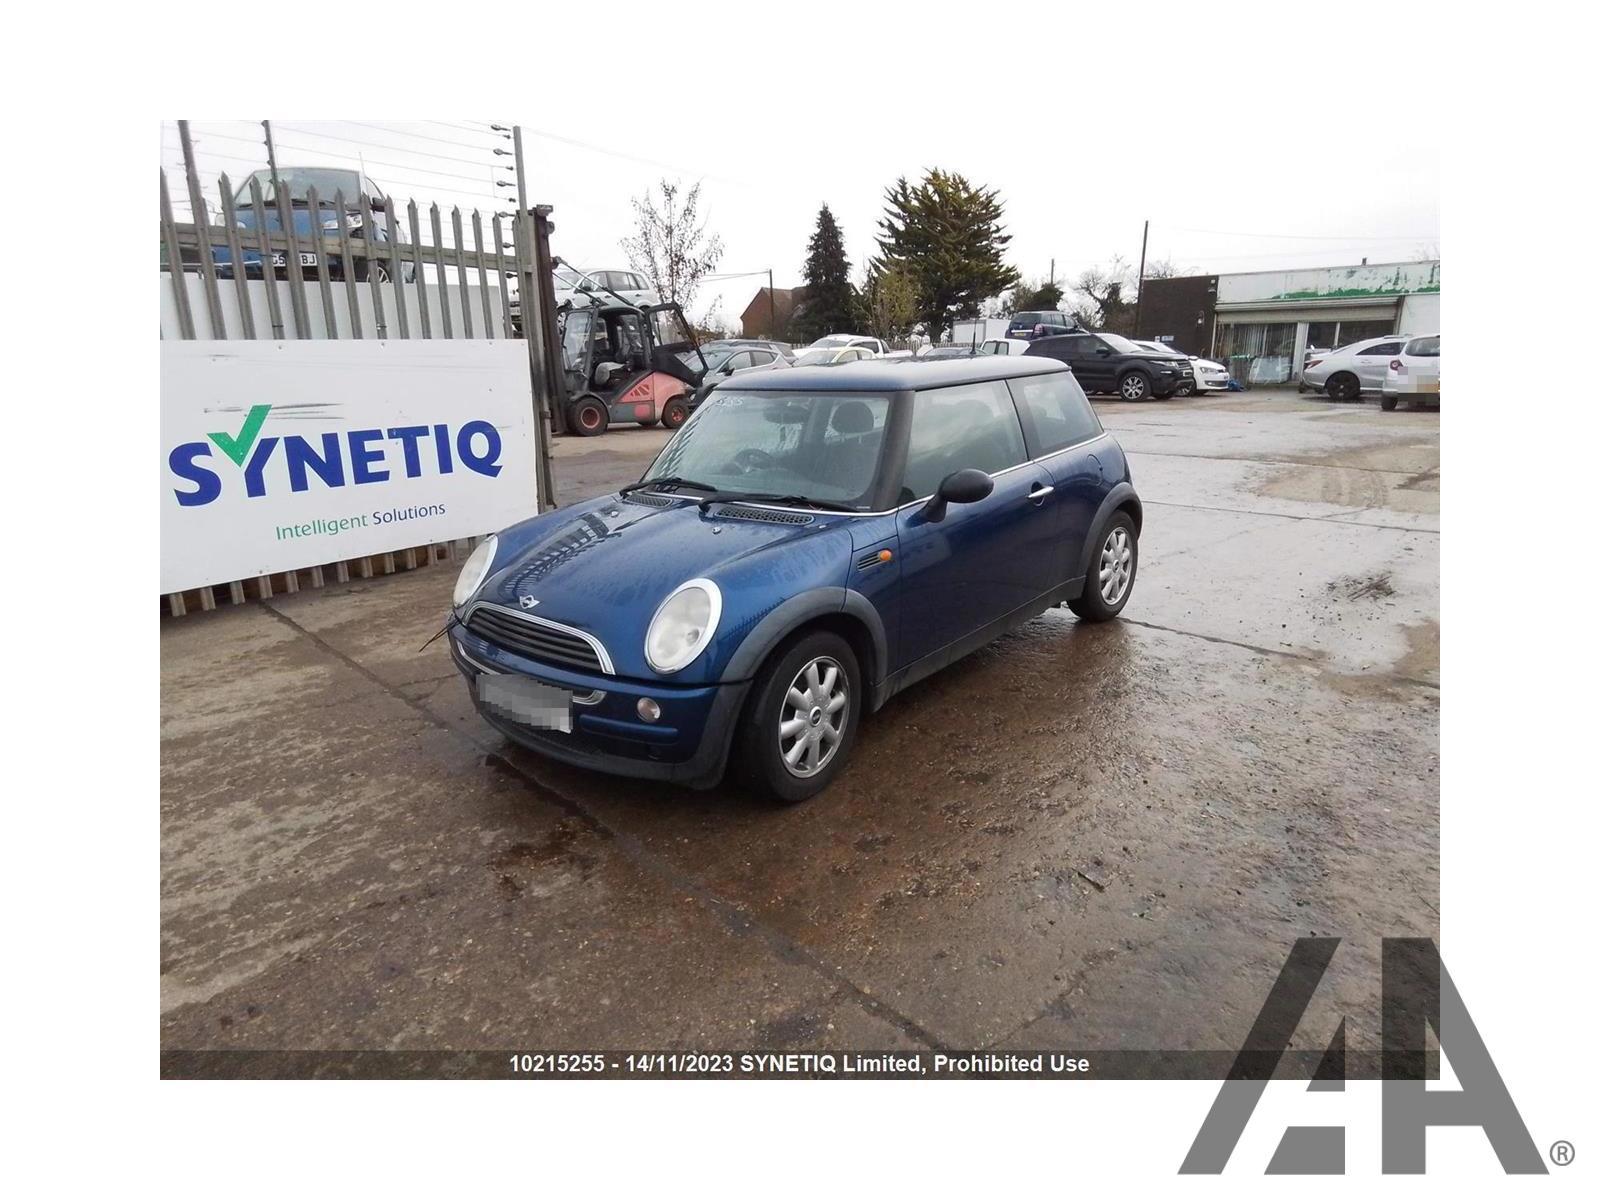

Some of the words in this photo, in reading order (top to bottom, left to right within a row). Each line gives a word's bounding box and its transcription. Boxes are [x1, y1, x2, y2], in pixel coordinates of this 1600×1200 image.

[168, 404, 503, 507] SYNETIQ
[275, 515, 368, 540] Intelligent
[372, 503, 446, 525] Solutions
